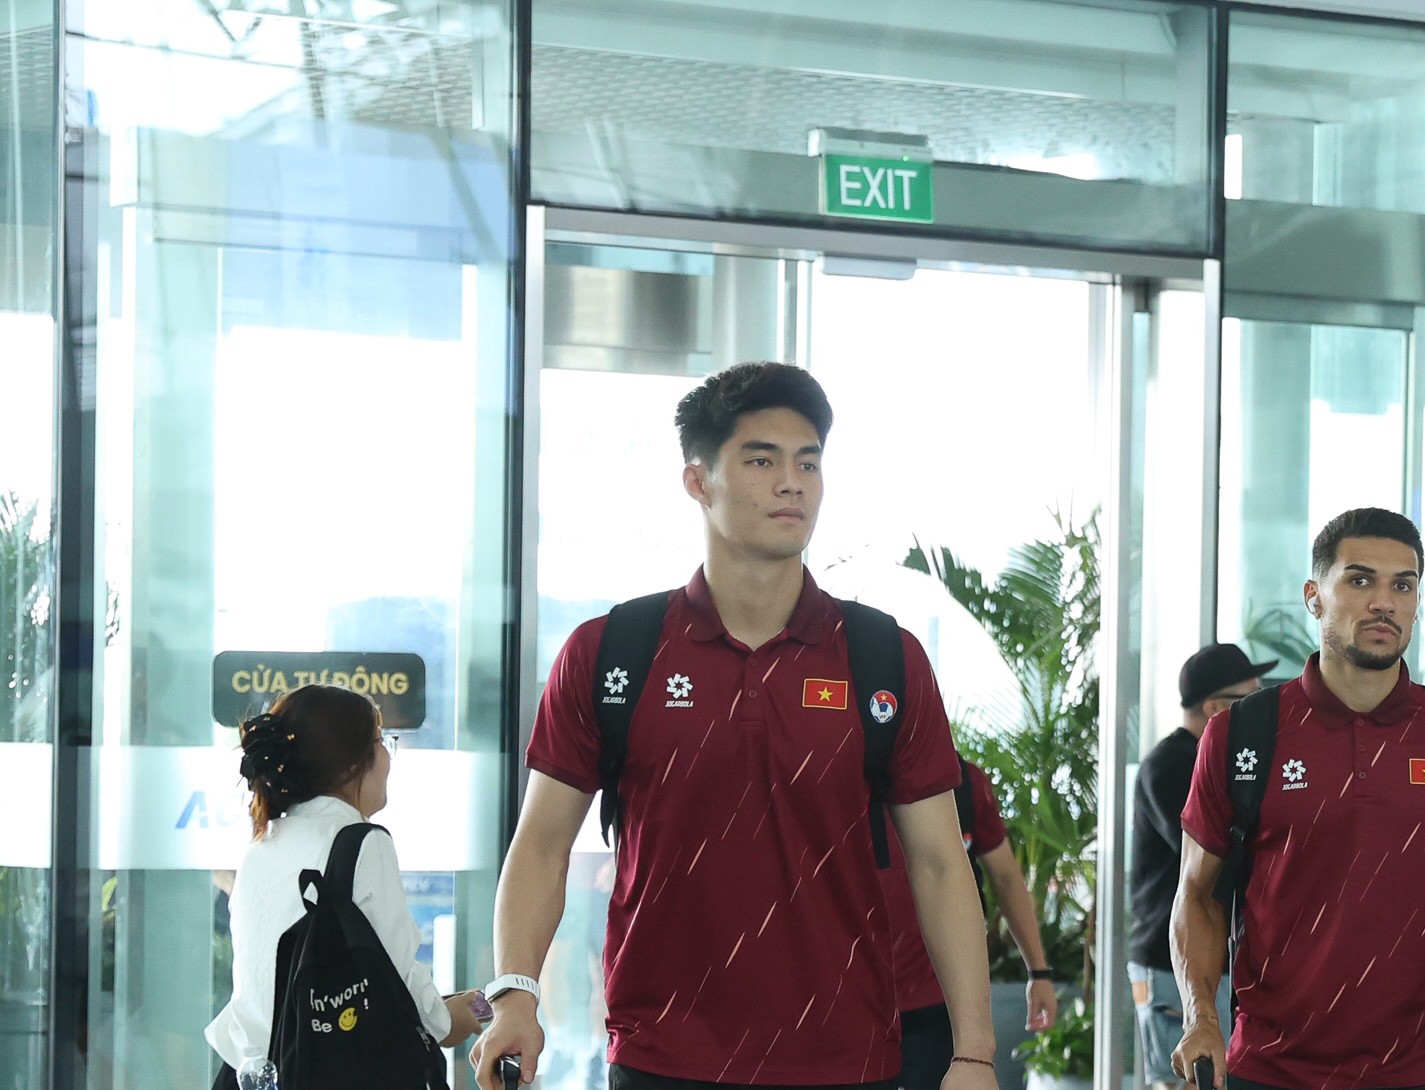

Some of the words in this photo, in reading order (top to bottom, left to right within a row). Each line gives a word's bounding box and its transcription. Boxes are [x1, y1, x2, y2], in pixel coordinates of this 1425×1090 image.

[839, 164, 918, 211] EXIT
[231, 663, 288, 694] CỬA
[311, 1018, 333, 1033] Be
